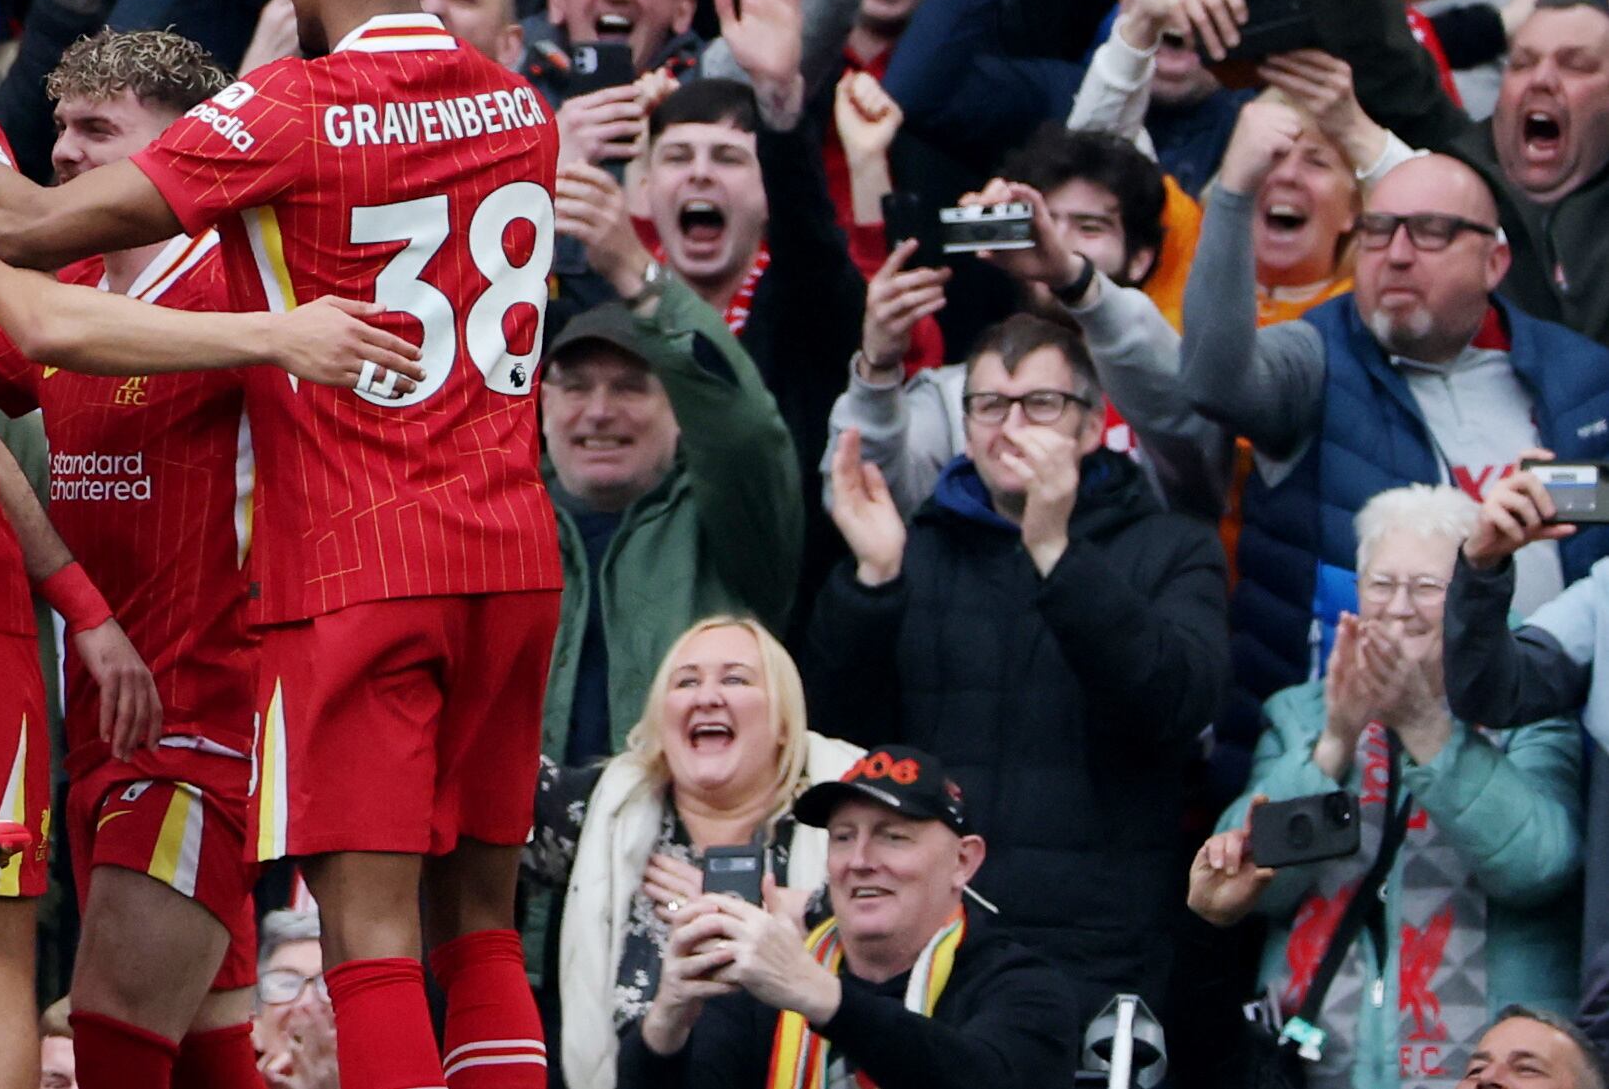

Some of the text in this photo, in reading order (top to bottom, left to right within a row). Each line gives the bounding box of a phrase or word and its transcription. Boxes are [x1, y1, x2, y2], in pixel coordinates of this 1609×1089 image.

[184, 103, 255, 152] pedia
[324, 86, 546, 148] GRAVENBERCH
[350, 181, 555, 407] 38
[114, 390, 148, 406] LFC
[51, 450, 143, 475] standard
[50, 475, 151, 501] chartered
